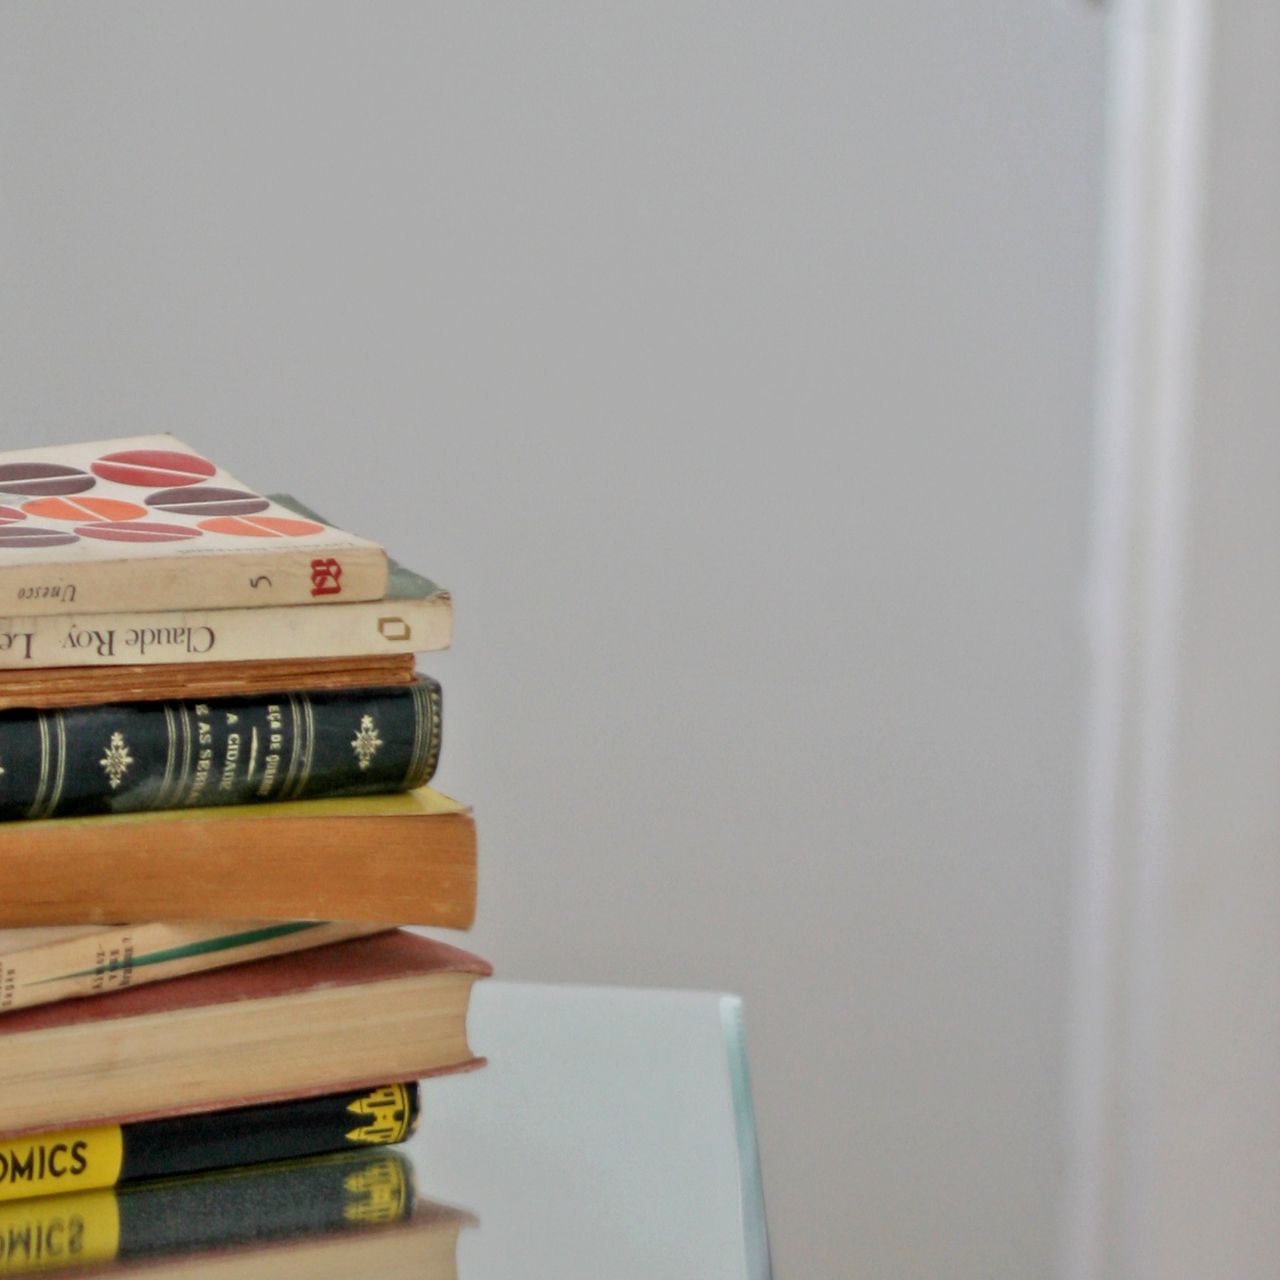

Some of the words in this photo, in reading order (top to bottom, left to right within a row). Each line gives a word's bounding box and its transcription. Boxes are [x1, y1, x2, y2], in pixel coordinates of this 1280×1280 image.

[17, 584, 76, 603] Unesco
[62, 623, 115, 658] Roy
[124, 626, 216, 656] Claude
[226, 712, 239, 726] A
[198, 722, 212, 744] AS
